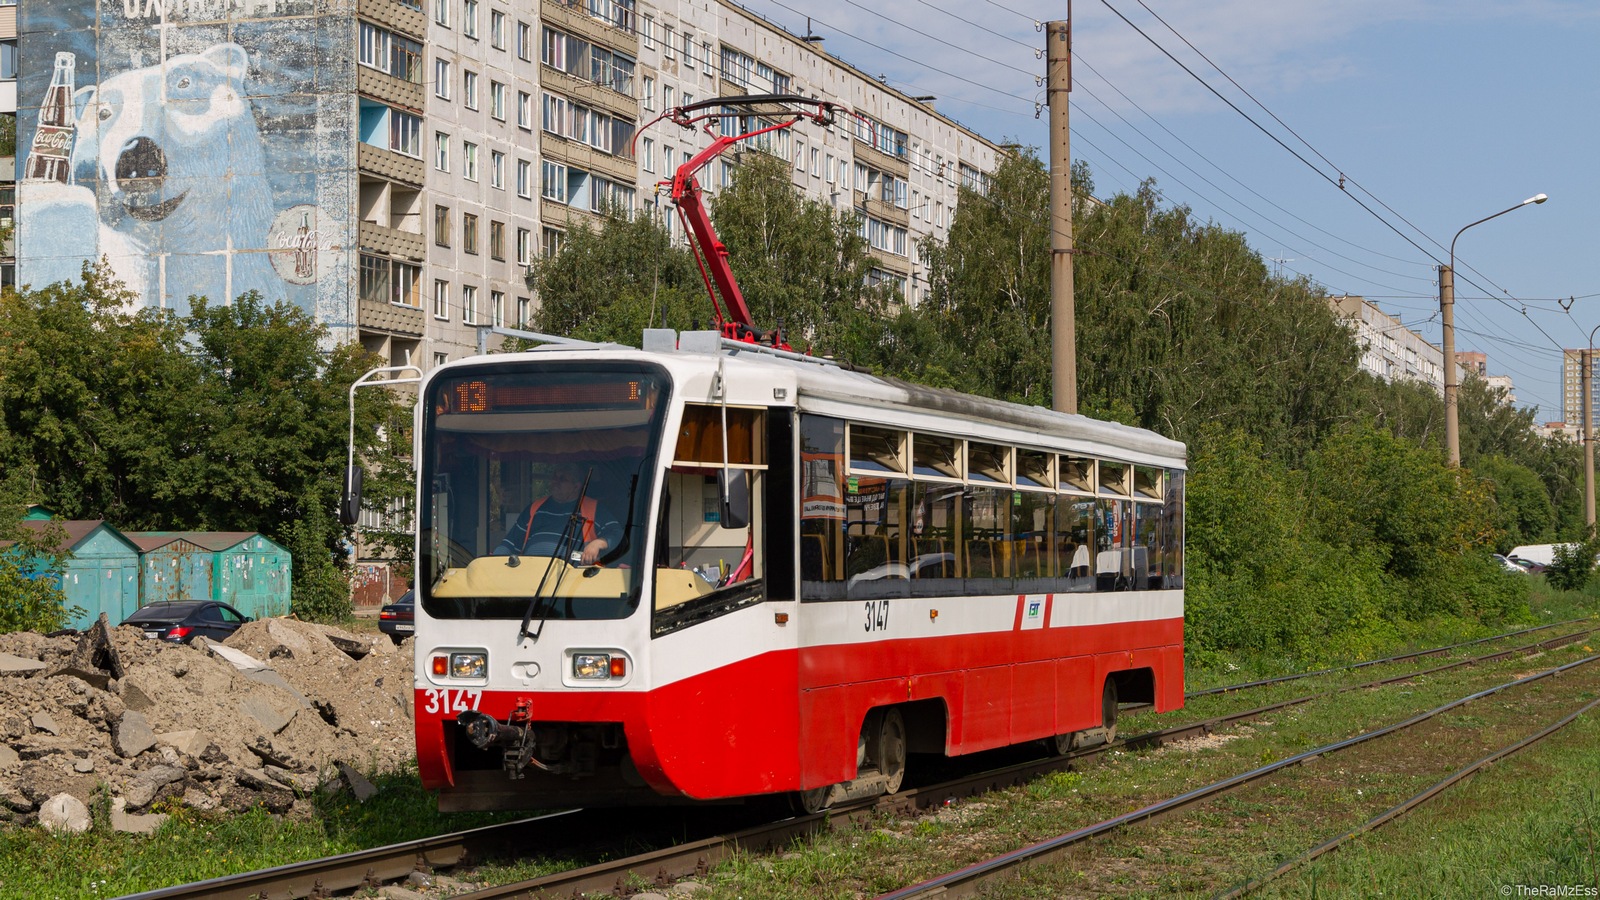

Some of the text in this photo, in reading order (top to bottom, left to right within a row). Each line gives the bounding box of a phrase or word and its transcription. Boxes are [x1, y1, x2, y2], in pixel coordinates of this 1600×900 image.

[456, 381, 486, 411] 13
[864, 600, 889, 632] 3147
[424, 688, 482, 714] 3147
